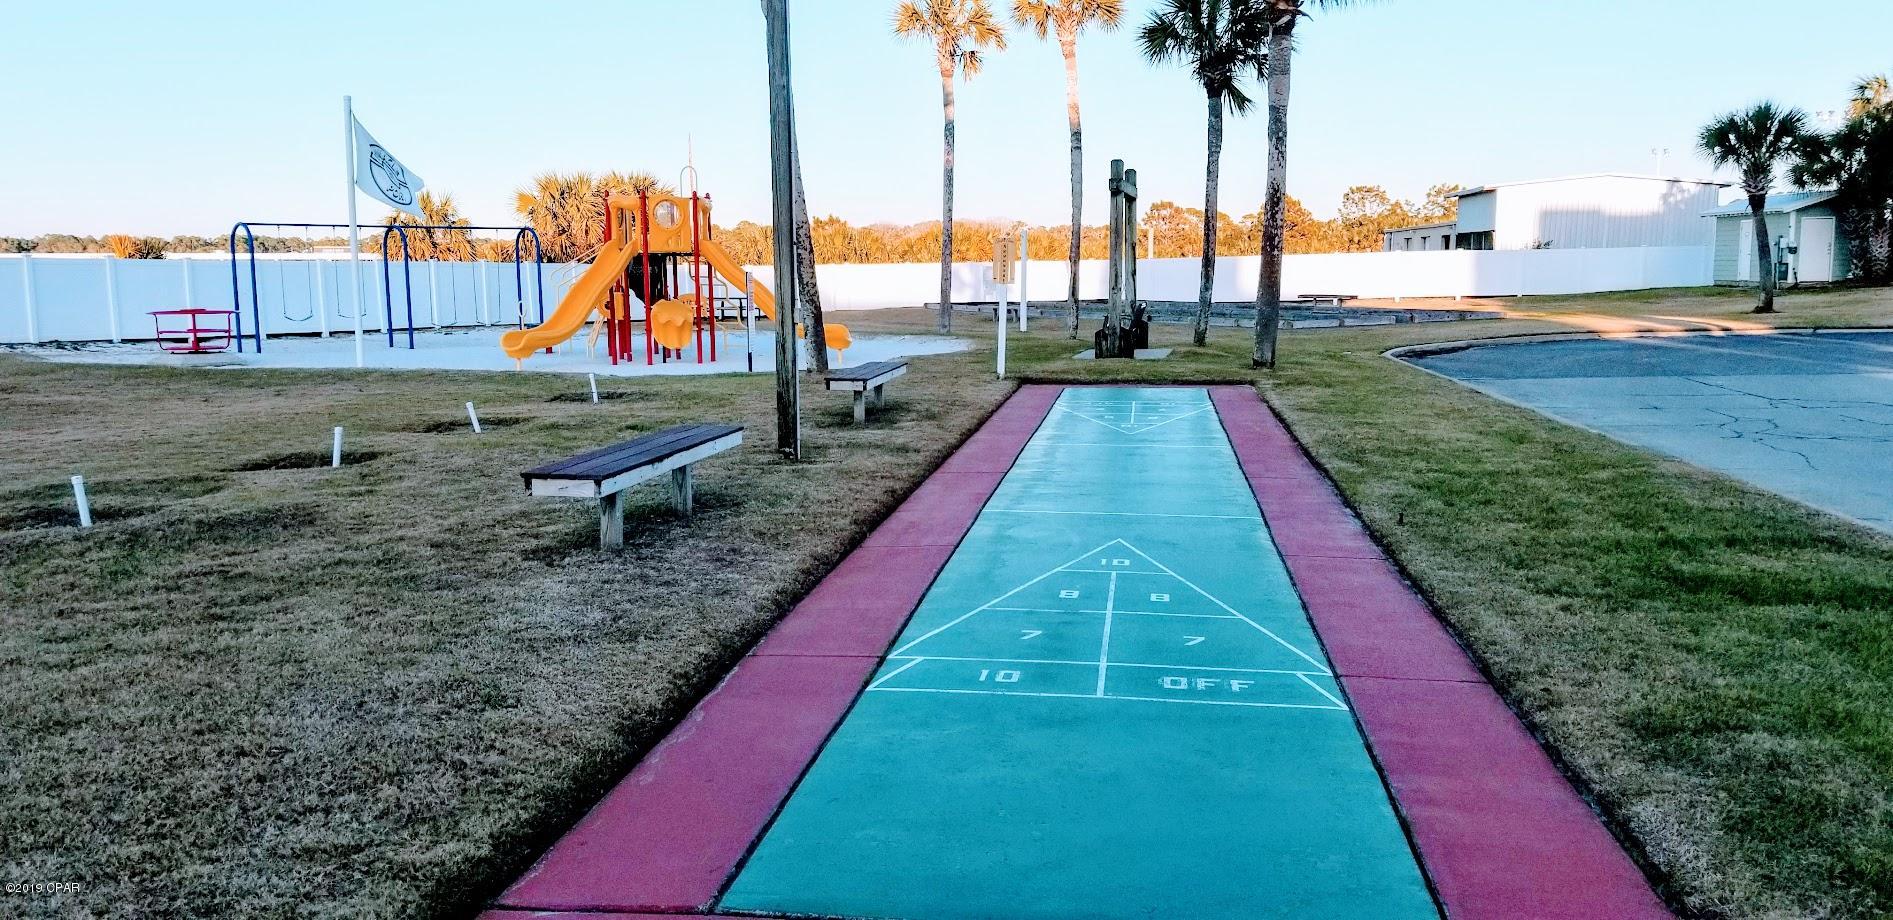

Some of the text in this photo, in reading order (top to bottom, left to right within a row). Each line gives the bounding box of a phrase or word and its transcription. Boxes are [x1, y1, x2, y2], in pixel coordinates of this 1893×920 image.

[1101, 558, 1131, 566] 10
[1150, 593, 1171, 602] 8
[1020, 630, 1042, 640] 7
[1183, 636, 1206, 646] 7
[978, 669, 1021, 683] 10
[1161, 676, 1256, 693] OFF
